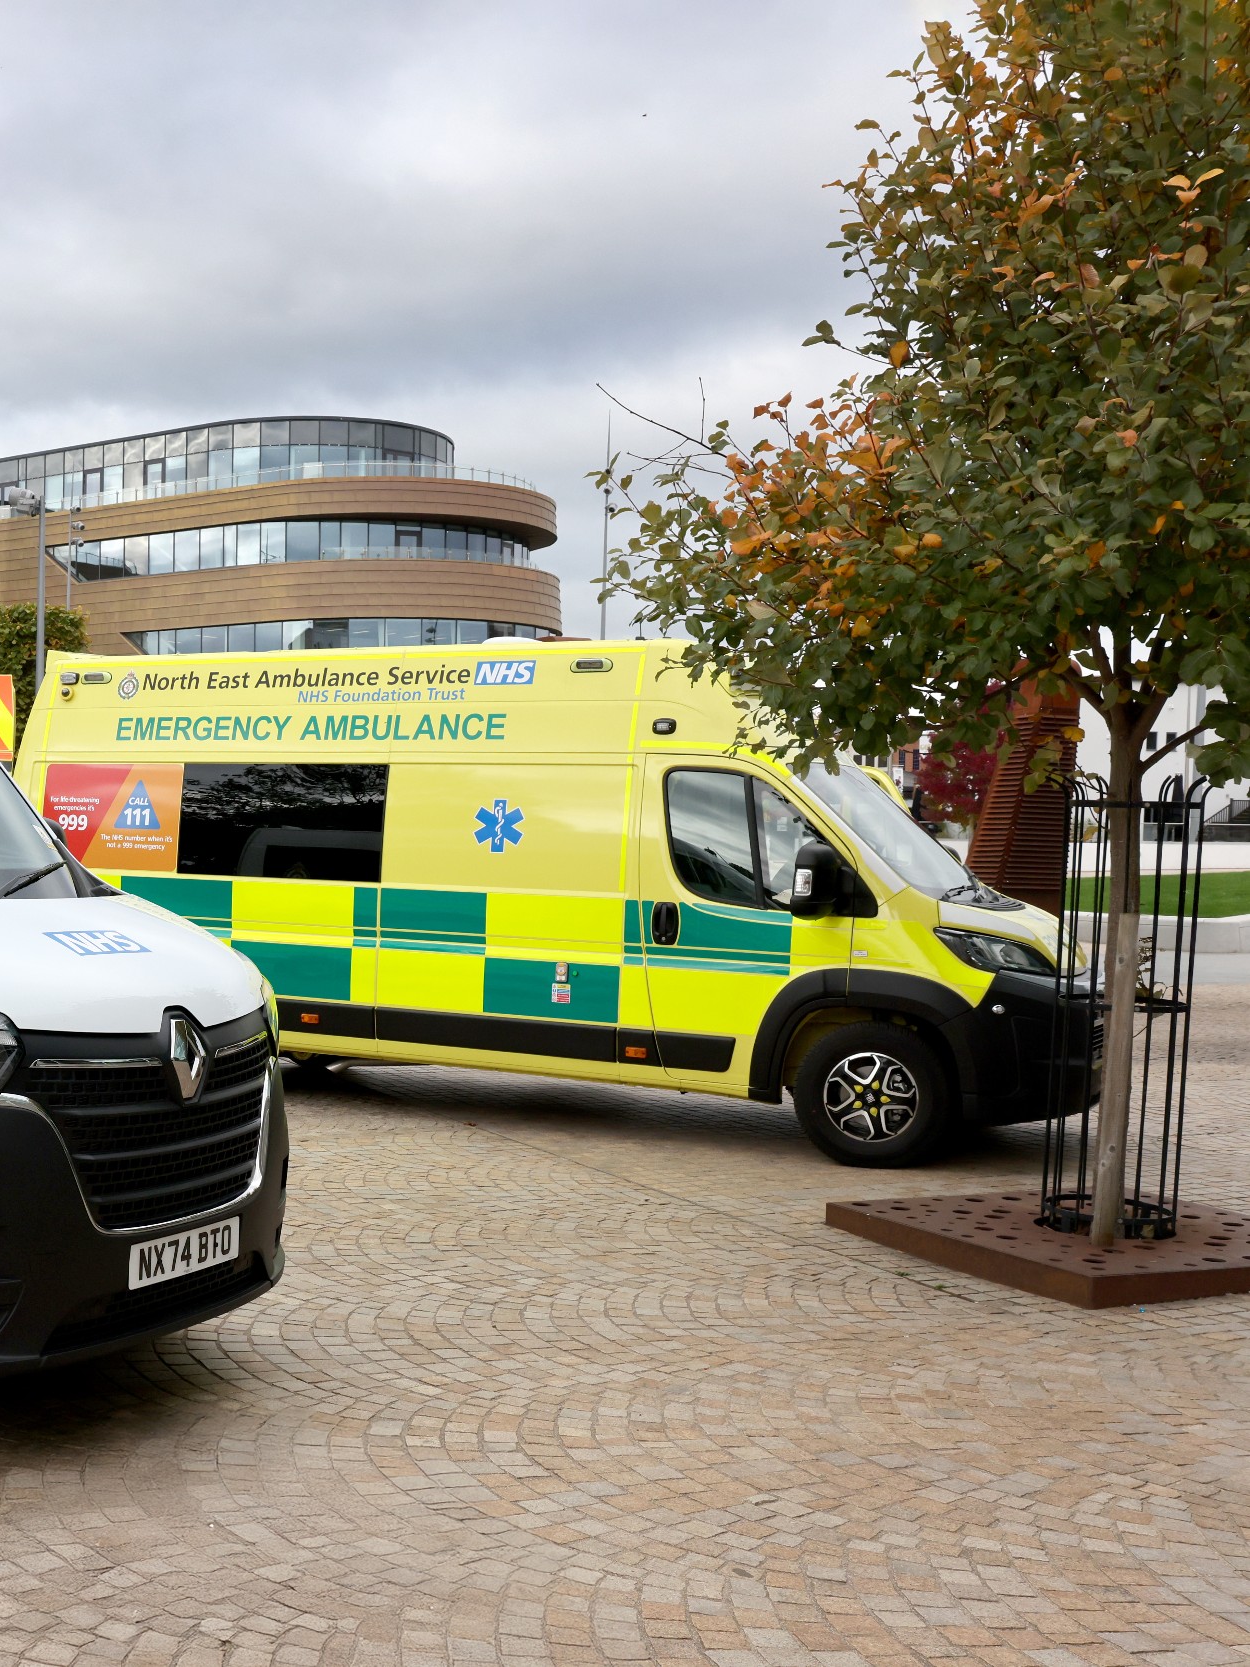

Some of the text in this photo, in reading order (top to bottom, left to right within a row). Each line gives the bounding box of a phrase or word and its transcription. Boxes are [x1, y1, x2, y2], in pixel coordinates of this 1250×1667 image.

[142, 661, 535, 691] North East Ambulance Service NHS
[297, 687, 465, 703] NHS Foundation Trust
[115, 713, 507, 742] EMERGENCY AMBULANCE
[50, 795, 100, 804] For life-threatening
[128, 797, 149, 806] CALL
[58, 814, 88, 831] 999
[123, 807, 150, 826] 111
[101, 833, 111, 841] The
[124, 834, 147, 842] number
[134, 843, 166, 851] emergency
[53, 931, 141, 954] NHS
[139, 1224, 232, 1281] NX74 BTO
